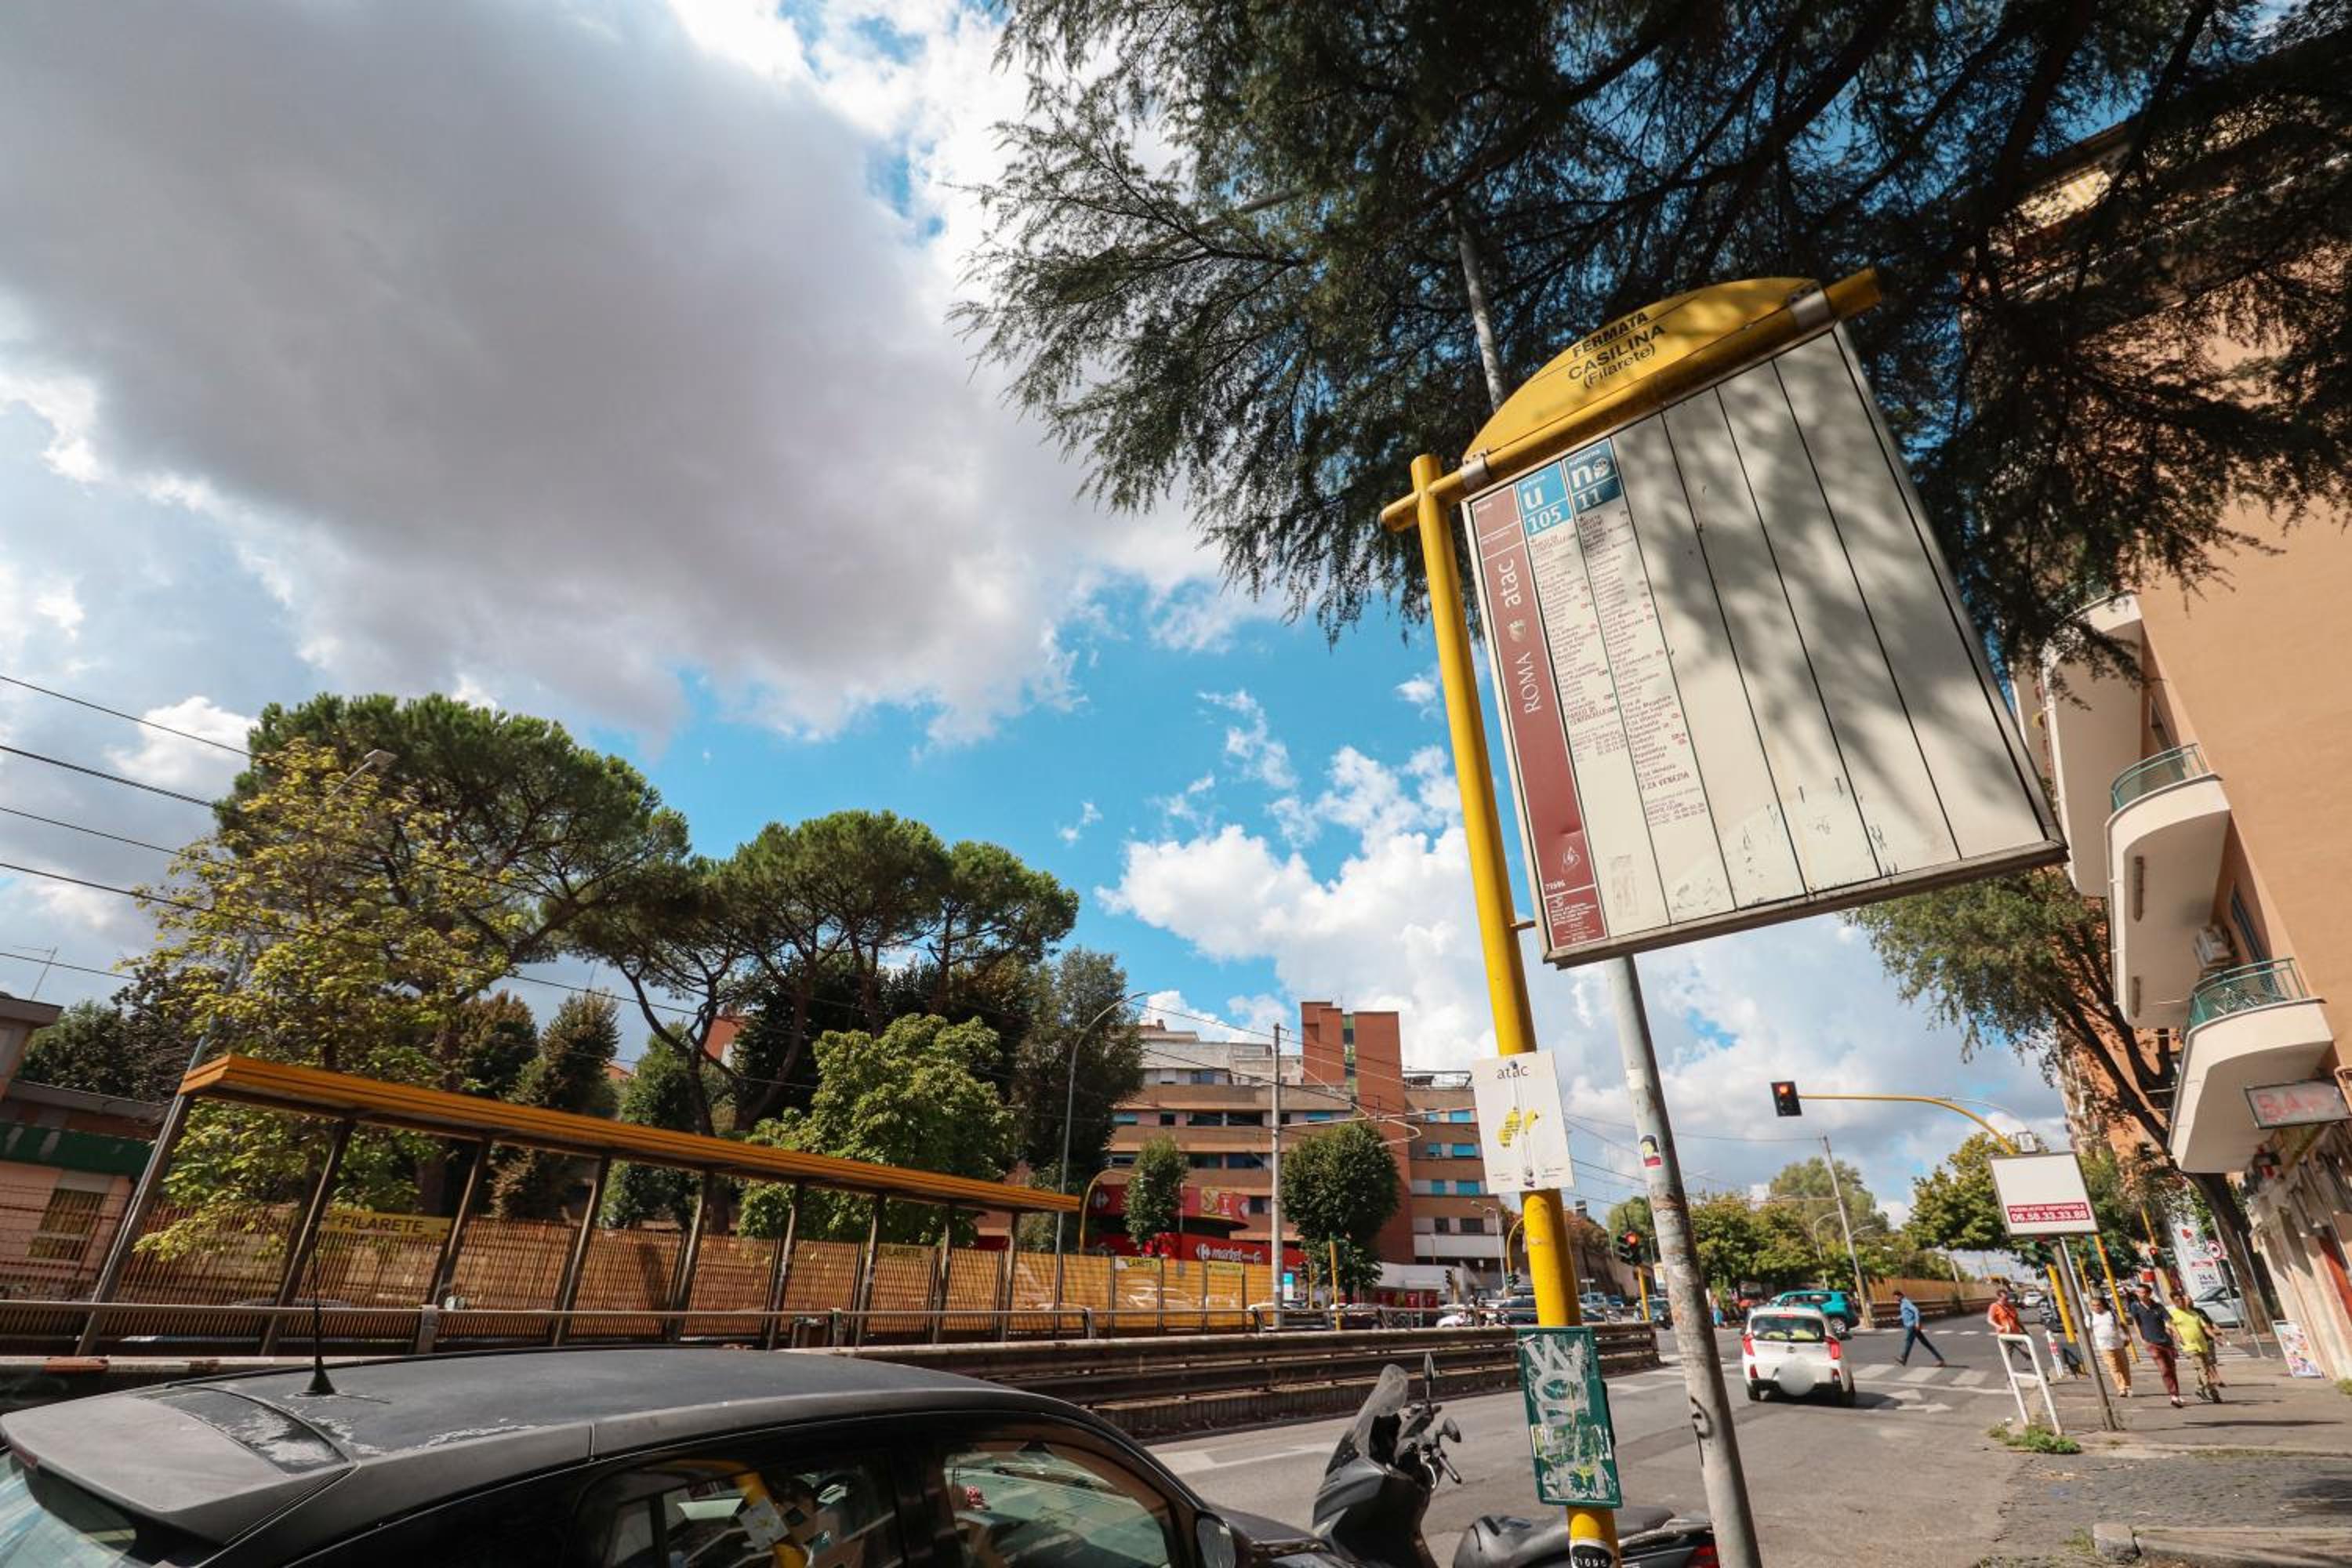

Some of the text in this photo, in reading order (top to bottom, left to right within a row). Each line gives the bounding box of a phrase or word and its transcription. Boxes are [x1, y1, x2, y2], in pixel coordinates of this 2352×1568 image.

[1569, 325, 1665, 379] CASILINA
[1572, 312, 1649, 358] FERMATA
[1584, 343, 1656, 389] (Filarete)
[1523, 487, 1544, 510] u
[1578, 488, 1602, 510] 11
[1529, 506, 1562, 532] 105
[1498, 558, 1523, 609] atac
[1515, 652, 1541, 714] ROMA
[1497, 1064, 1530, 1080] atac
[339, 1215, 425, 1233] FILARETE
